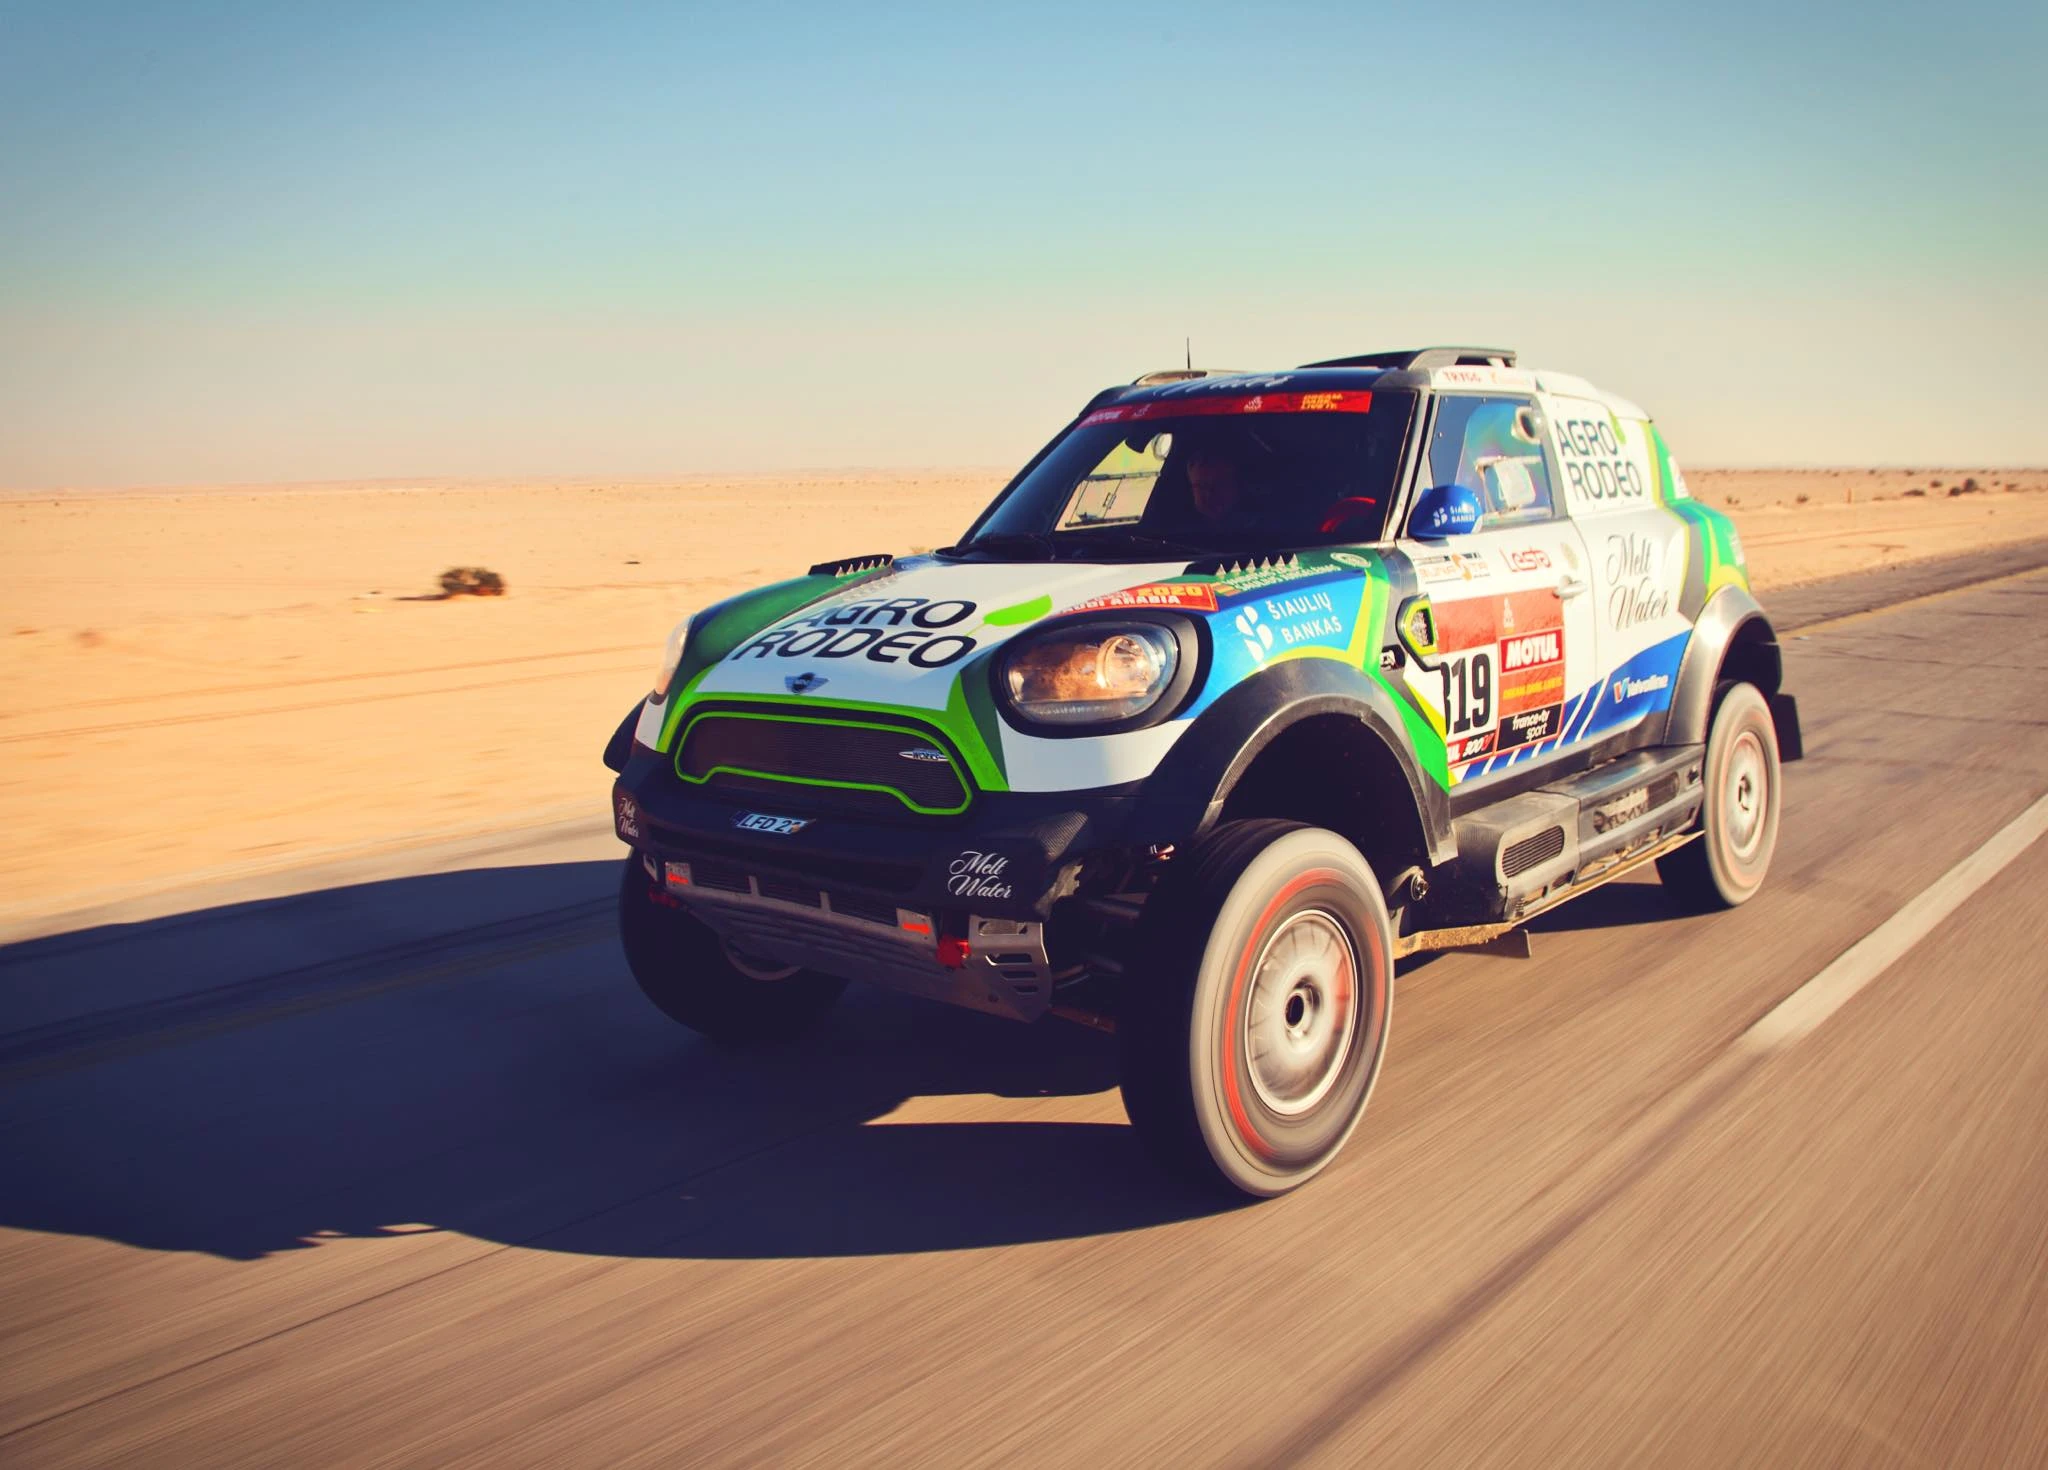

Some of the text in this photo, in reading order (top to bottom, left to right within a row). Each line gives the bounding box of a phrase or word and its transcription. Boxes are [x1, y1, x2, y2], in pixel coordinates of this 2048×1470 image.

[1554, 418, 1617, 458] AGRO
[1567, 460, 1643, 502] RODEO
[1606, 532, 1653, 587] Melt
[1110, 594, 1181, 606] ARABIA
[1137, 585, 1203, 597] 2020
[1609, 576, 1668, 632] Water
[781, 597, 977, 629] AGRO
[1281, 615, 1342, 644] BANKAS
[732, 628, 977, 669] RODEO
[1505, 633, 1559, 669] MOTUL
[1462, 733, 1495, 758] 300V
[1526, 723, 1547, 742] sport
[740, 814, 777, 830] LFD
[949, 850, 1009, 875] Melt
[947, 874, 1013, 899] Water
